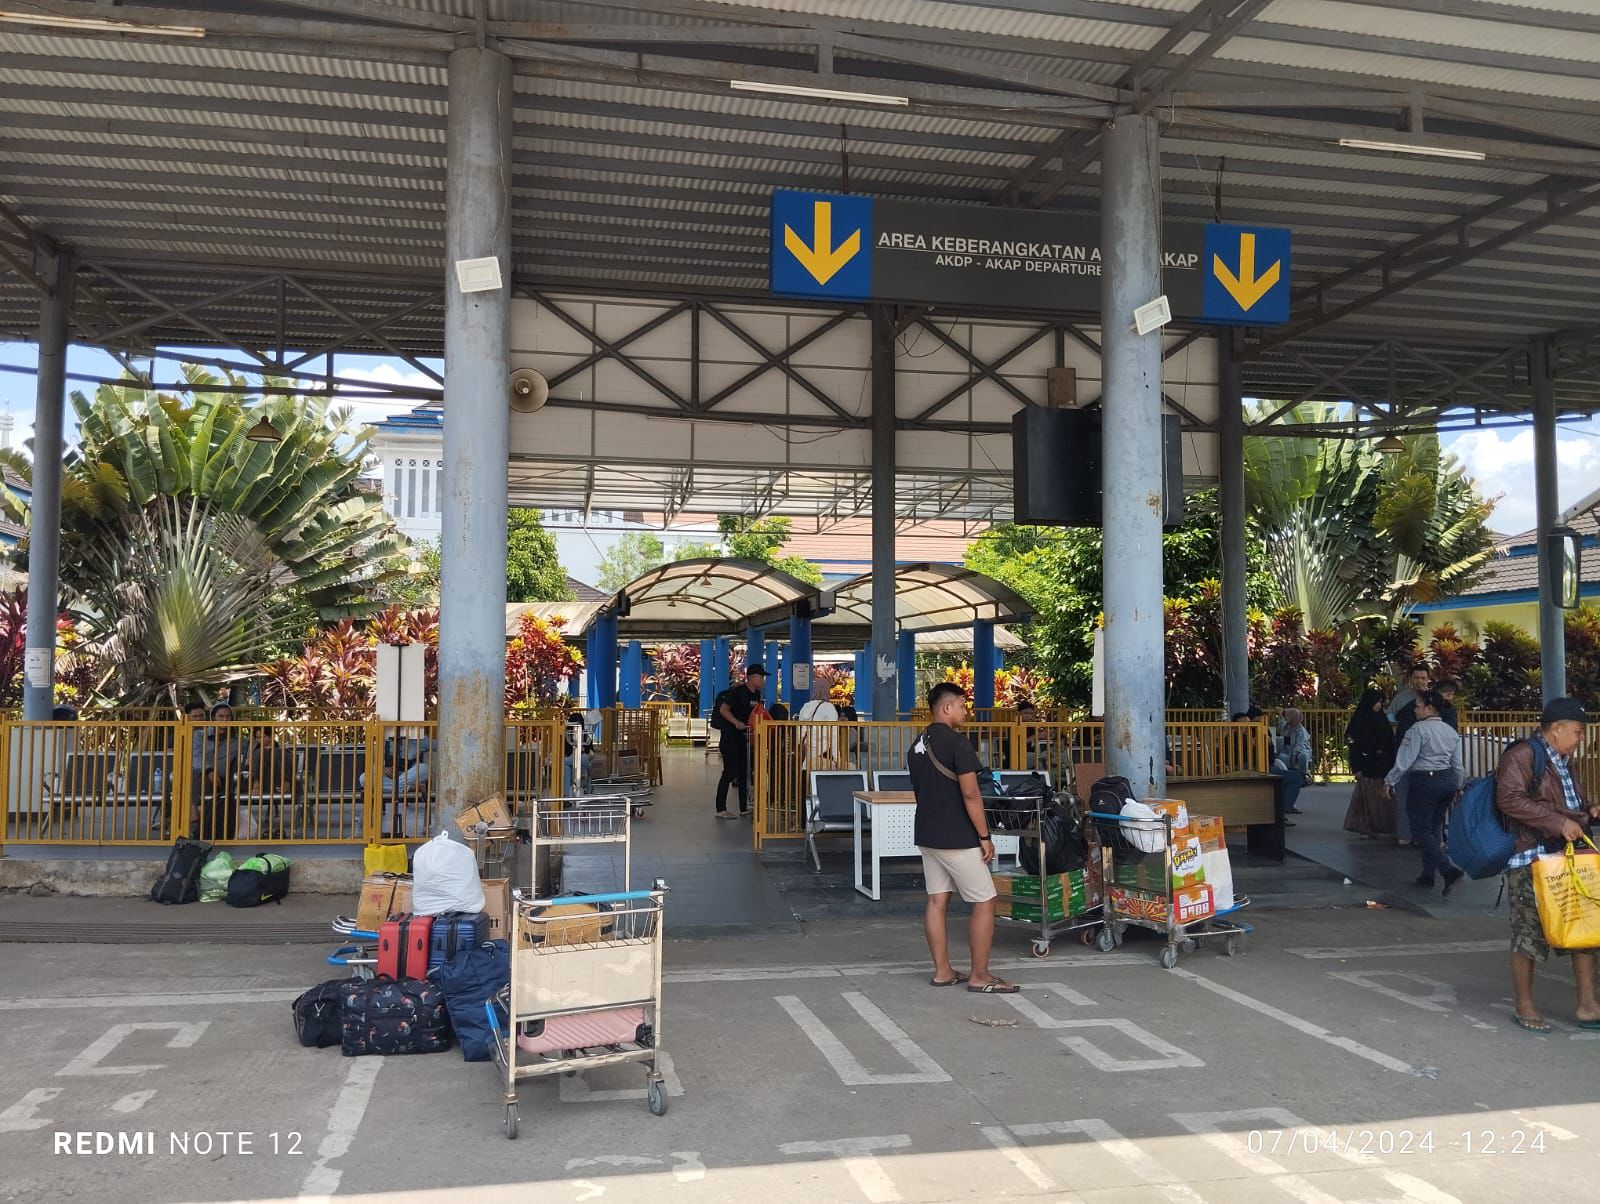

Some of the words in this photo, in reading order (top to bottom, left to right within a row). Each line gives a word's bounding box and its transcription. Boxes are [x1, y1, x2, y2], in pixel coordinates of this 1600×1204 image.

[878, 232, 927, 249] AREA
[931, 236, 1086, 260] KEBERANGKATAN
[935, 254, 973, 268] AKDP
[985, 258, 1021, 271] AKAP
